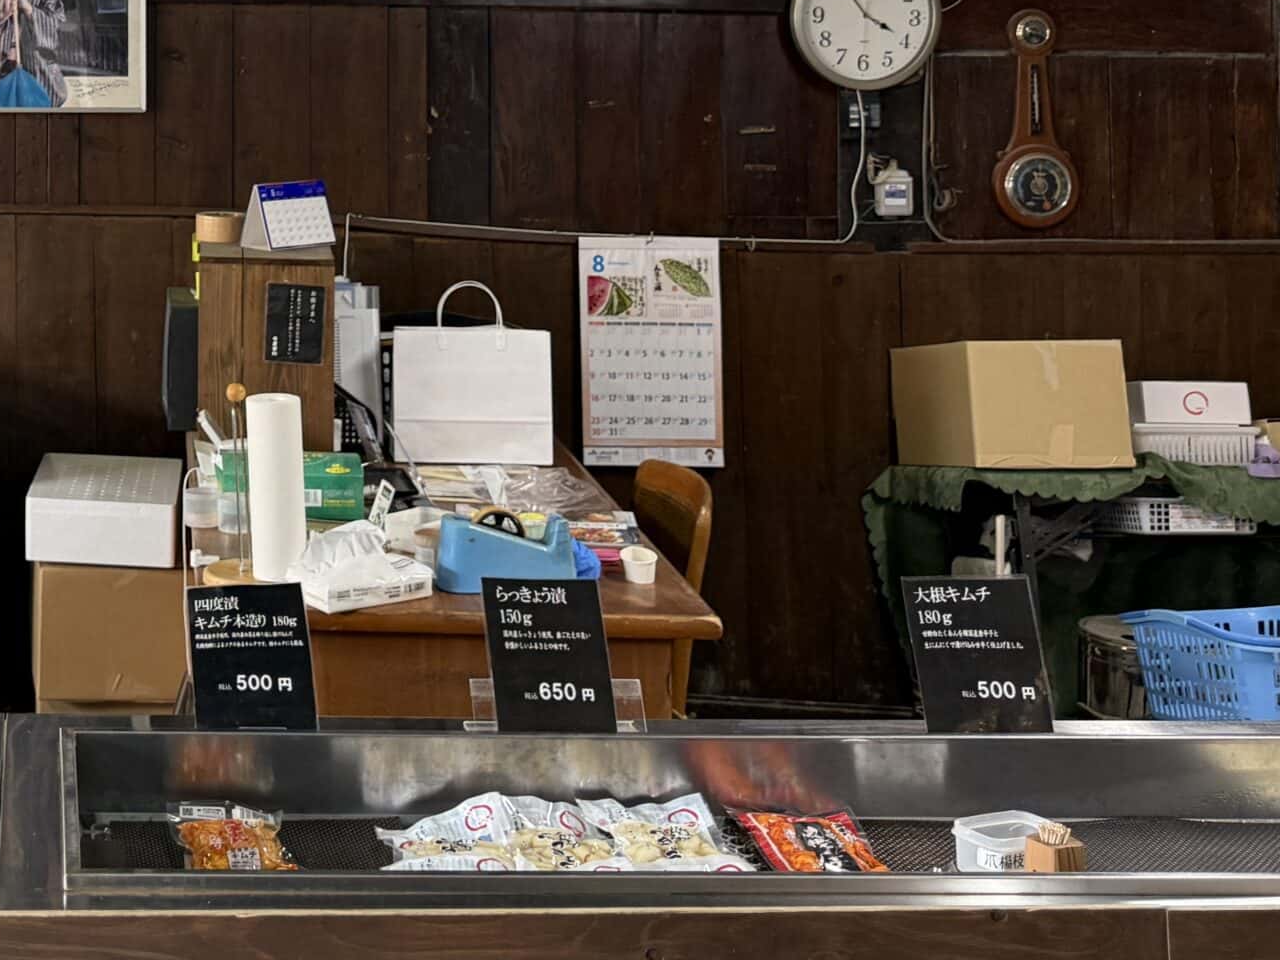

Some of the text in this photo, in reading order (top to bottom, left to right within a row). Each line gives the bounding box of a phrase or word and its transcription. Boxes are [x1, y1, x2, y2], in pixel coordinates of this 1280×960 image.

[812, 7, 824, 23] 9
[909, 9, 920, 26] 3
[819, 31, 831, 47] 8
[899, 33, 910, 48] 4
[835, 48, 848, 65] 7
[857, 54, 869, 71] 6
[881, 51, 893, 67] 5
[592, 254, 605, 273] 8
[913, 586, 991, 603] 大根キムチ
[194, 596, 239, 612] 四度漬
[194, 614, 298, 630] キムチ本造り 180g
[500, 609, 533, 626] 150g
[918, 610, 953, 626] 180g
